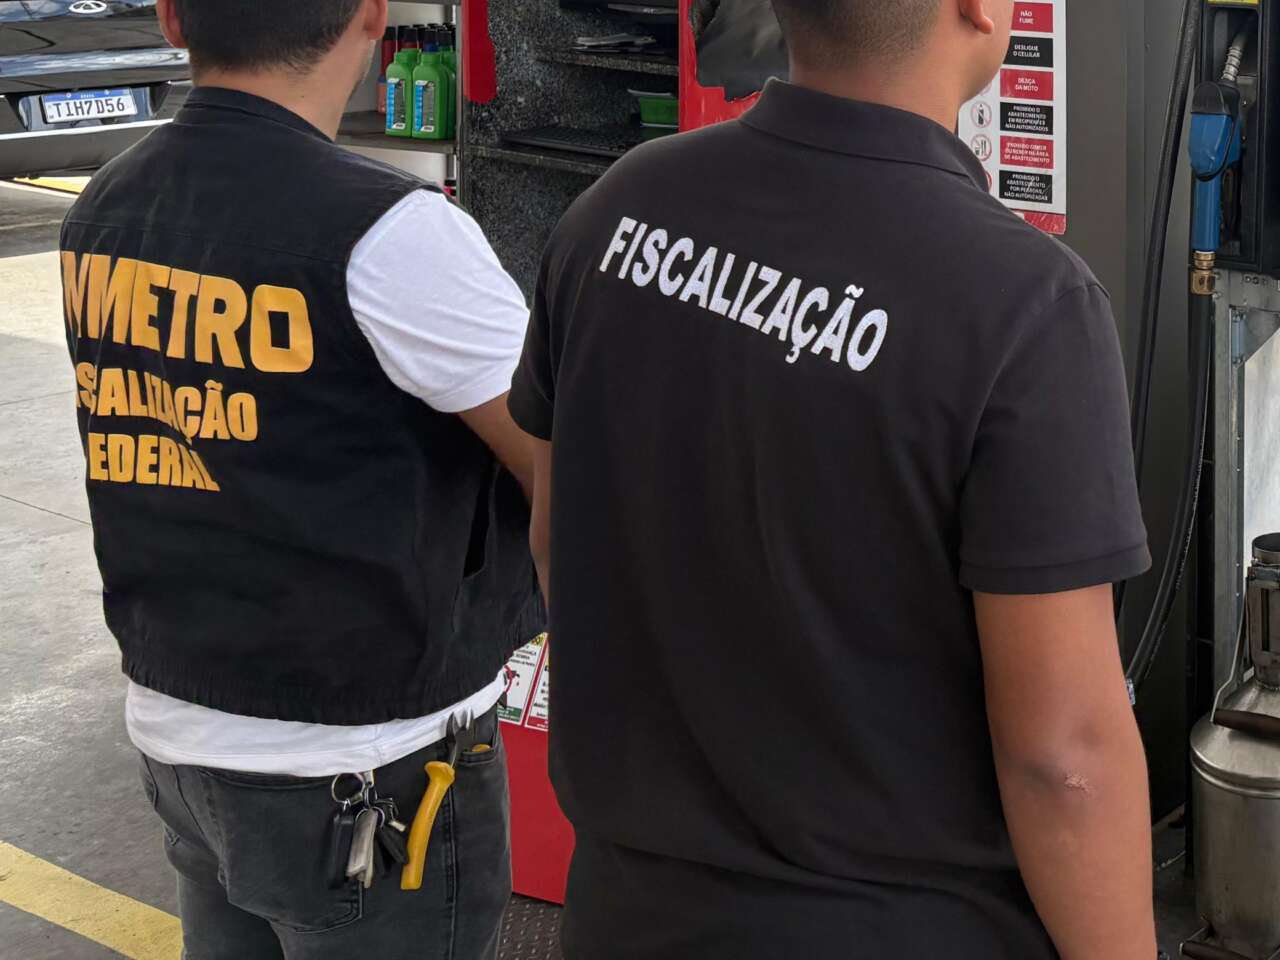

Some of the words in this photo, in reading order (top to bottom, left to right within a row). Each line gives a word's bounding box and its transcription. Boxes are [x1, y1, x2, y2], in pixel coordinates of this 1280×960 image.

[52, 98, 125, 118] TIH7D56
[599, 216, 889, 372] FISCALIZAÇÃO
[87, 432, 221, 492] EDERAL
